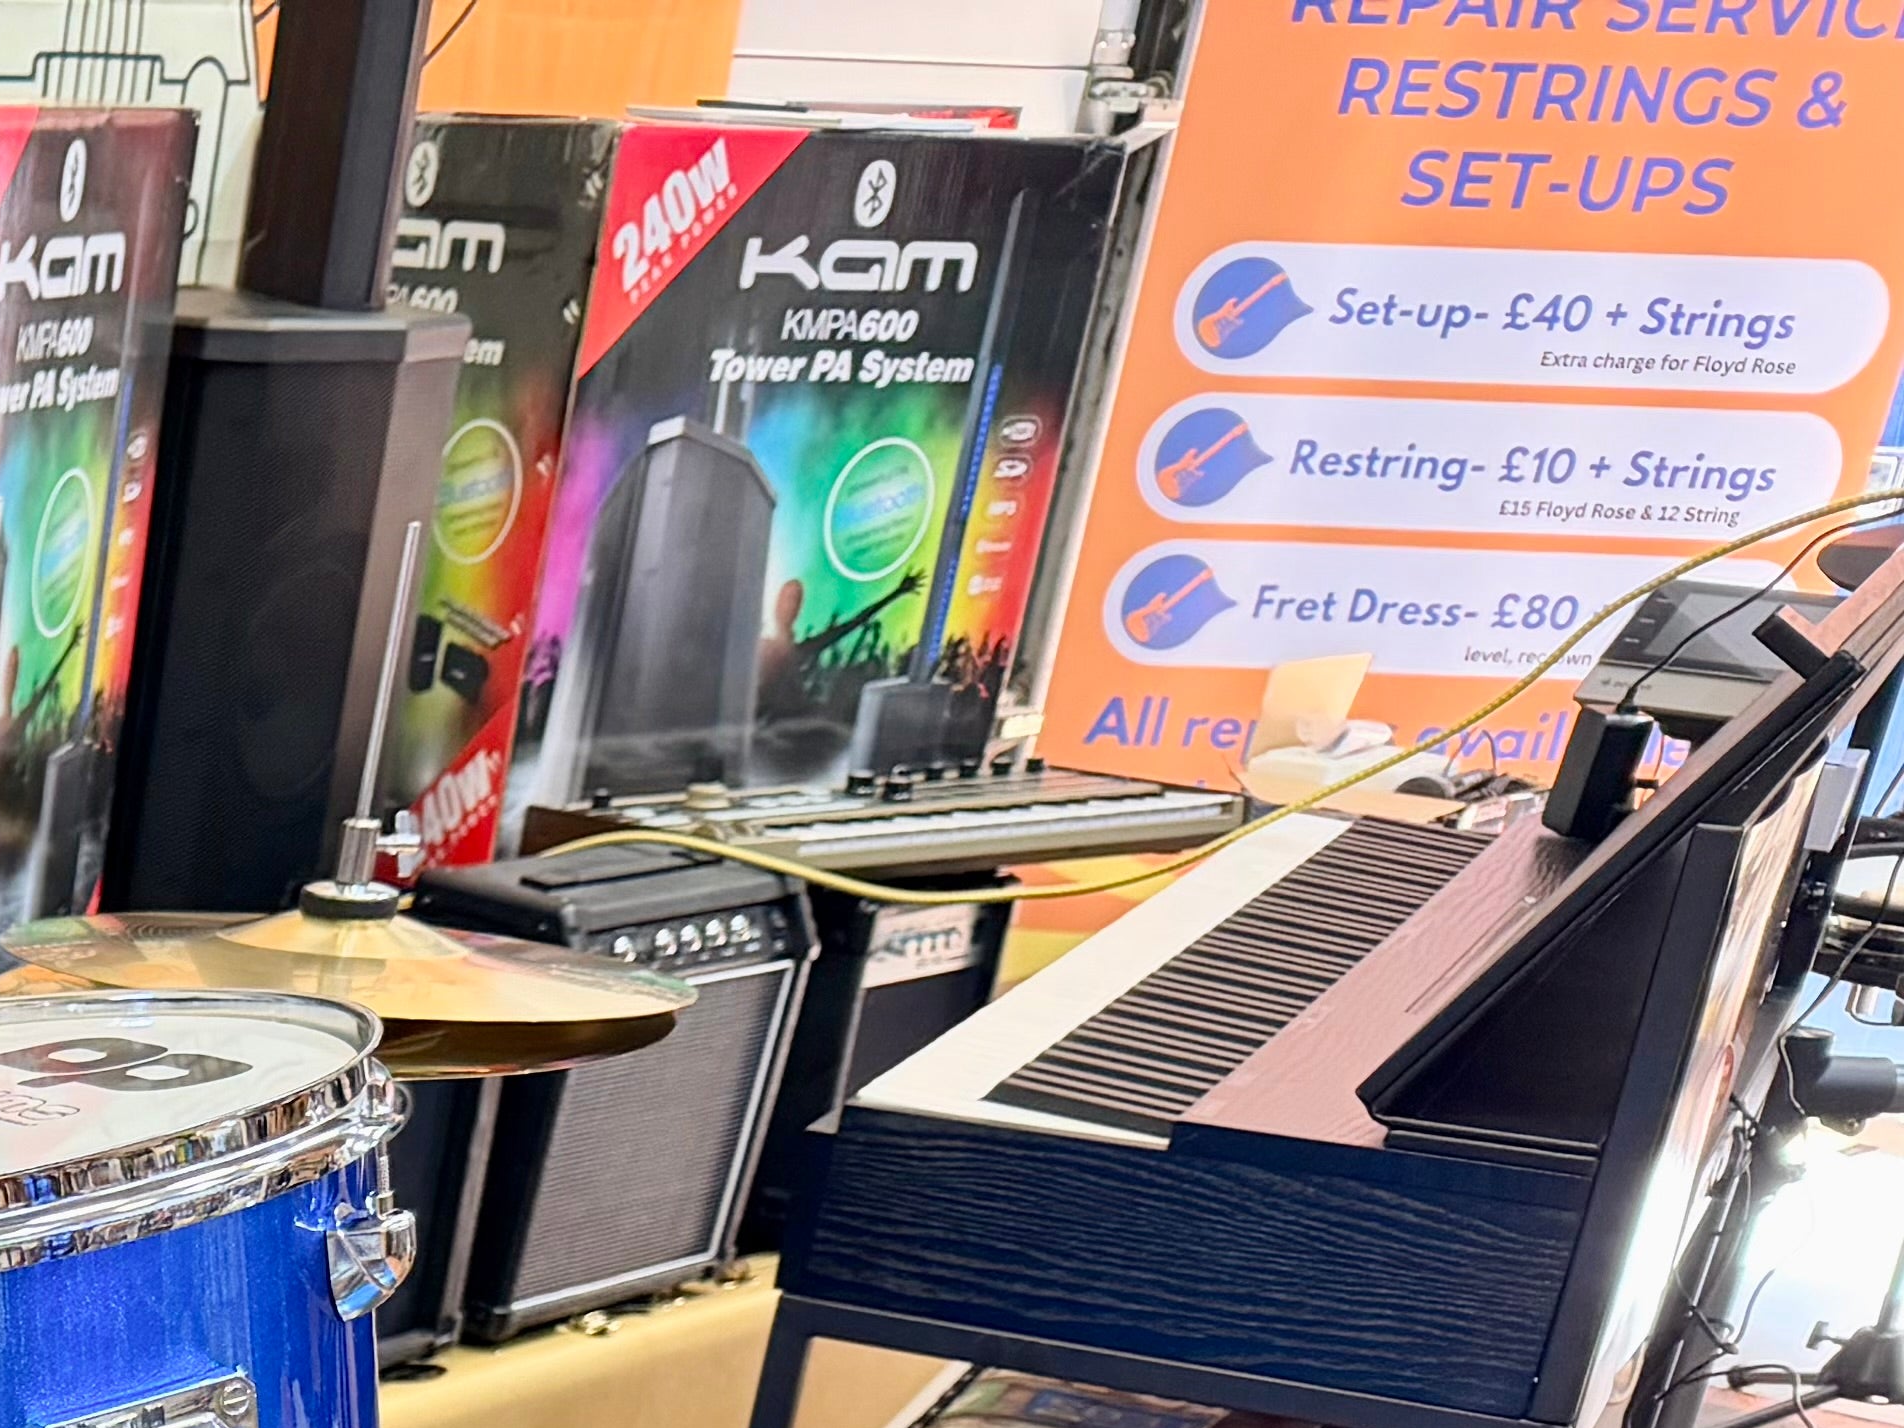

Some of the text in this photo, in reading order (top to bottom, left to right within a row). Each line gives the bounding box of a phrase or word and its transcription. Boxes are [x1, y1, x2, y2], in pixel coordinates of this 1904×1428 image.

[1606, 0, 1904, 39] SERVIC
[1338, 58, 1847, 128] RESTRINGS &
[1400, 149, 1735, 215] SET-UPS
[781, 309, 920, 342] KMPA600
[1328, 287, 1796, 350] Set-up- £40 + Strings
[709, 349, 975, 388] Tower PA System
[1540, 351, 1797, 377] Extra charge for Floyd Rose
[29, 369, 57, 409] PA
[57, 364, 121, 412] System
[1290, 439, 1776, 501] Restring- £10 + Strings
[1499, 500, 1740, 528] £15 Floyd Rose & 12 String
[1252, 584, 1580, 631] Fret Dress- £80
[1464, 645, 1513, 667] level,
[1083, 696, 1169, 746] All
